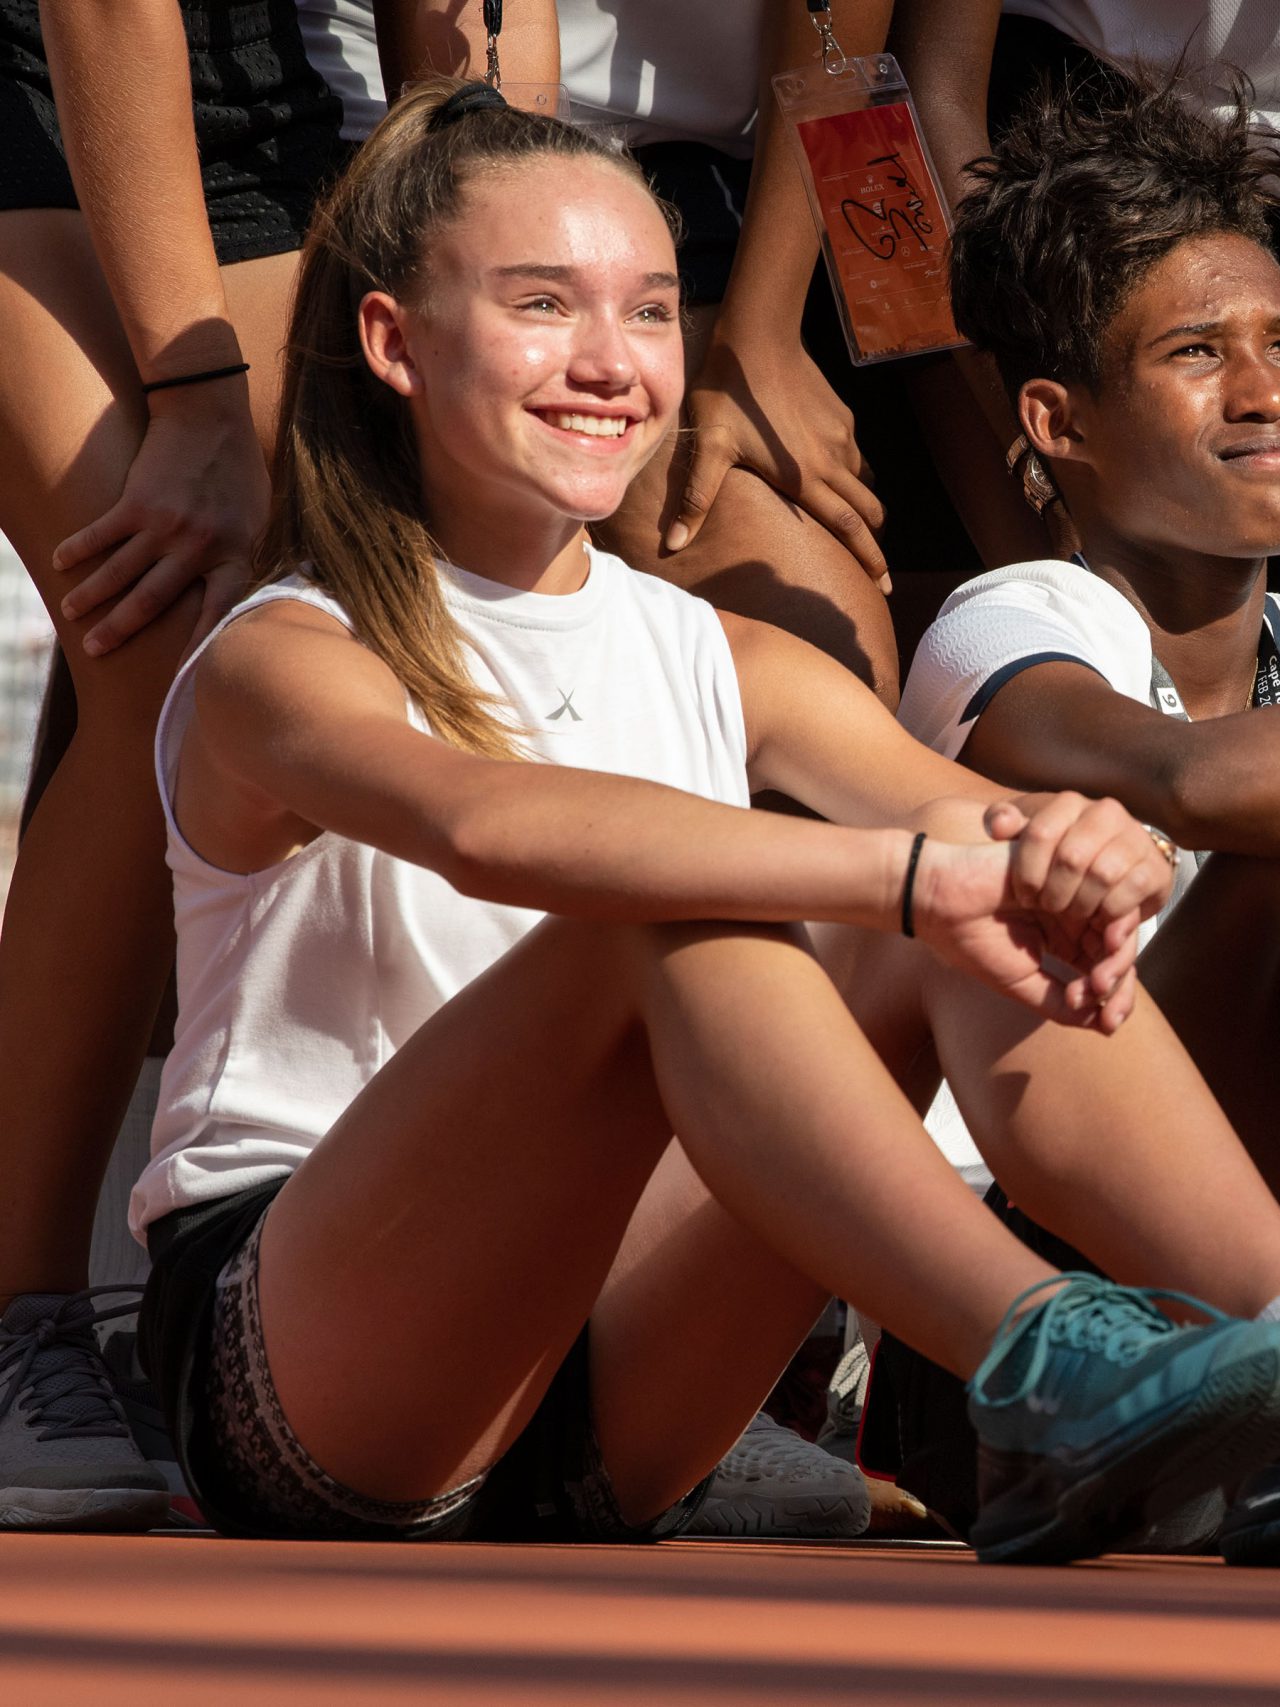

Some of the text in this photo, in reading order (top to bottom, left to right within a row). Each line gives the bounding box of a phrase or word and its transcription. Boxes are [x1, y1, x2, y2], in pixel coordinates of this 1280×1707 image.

[860, 184, 885, 194] ROLEX
[1268, 655, 1280, 687] Cape
[1258, 676, 1268, 694] FEB
[1162, 693, 1177, 708] 6
[1259, 695, 1273, 708] 20
